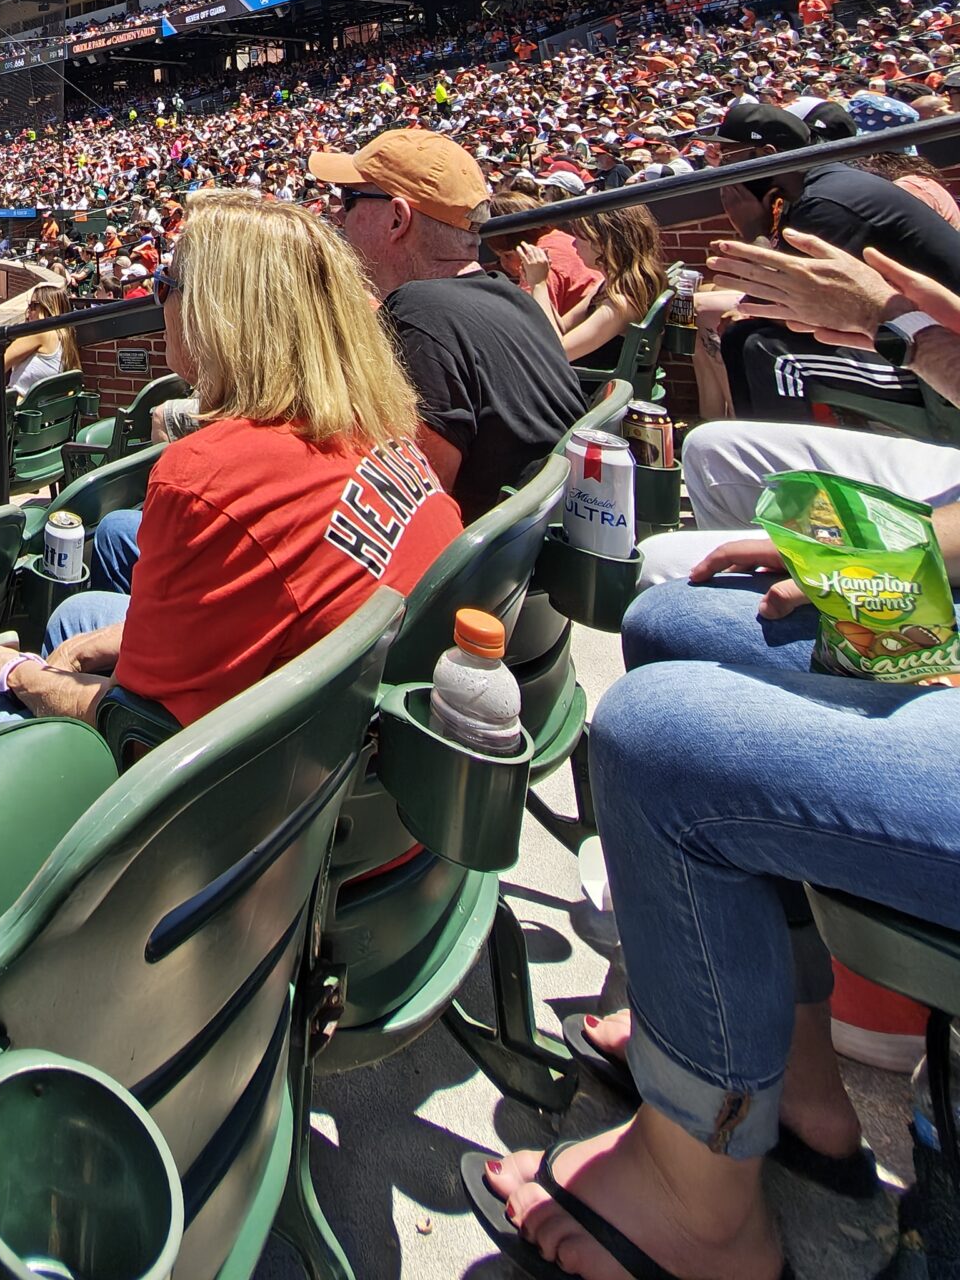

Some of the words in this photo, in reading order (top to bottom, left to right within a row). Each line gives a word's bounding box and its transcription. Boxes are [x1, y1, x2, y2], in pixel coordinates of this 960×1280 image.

[185, 12, 200, 24] NEVER
[200, 10, 209, 21] OFF
[72, 41, 92, 54] ORIOLE
[91, 38, 107, 49] PARK
[111, 31, 137, 44] CAMDEN
[136, 26, 157, 39] YARDS
[569, 487, 616, 510] Michelob
[564, 496, 628, 528] ULTRA
[45, 543, 69, 568] ite
[804, 569, 923, 598] Hampton
[846, 592, 917, 623] Farms
[909, 665, 951, 676] SALTED
